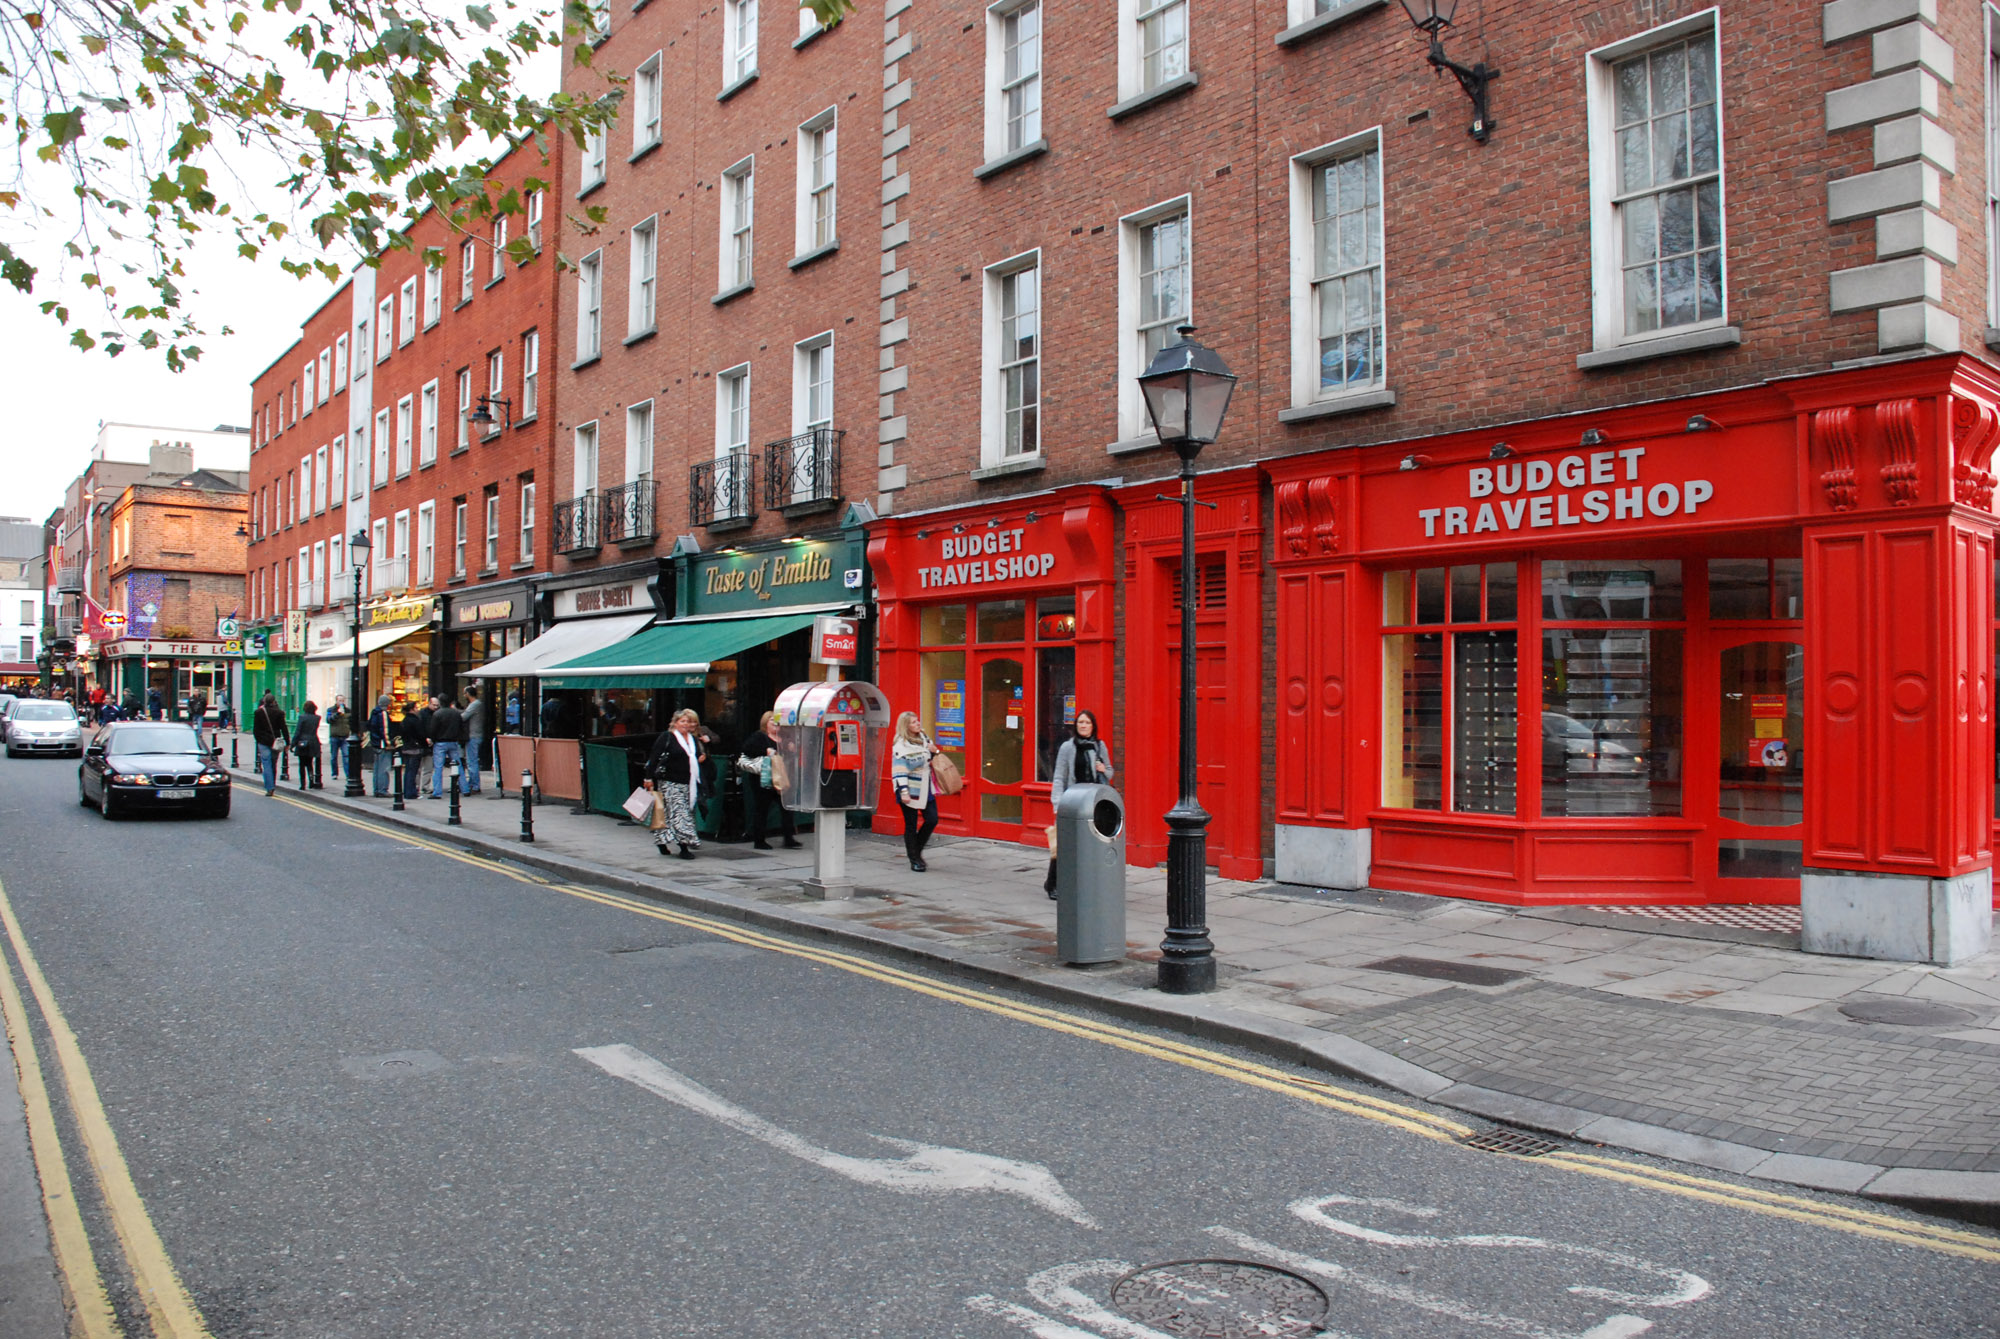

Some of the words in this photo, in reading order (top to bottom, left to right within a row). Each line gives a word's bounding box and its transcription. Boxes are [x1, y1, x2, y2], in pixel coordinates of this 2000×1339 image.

[1469, 447, 1646, 498] BUDGET
[1418, 479, 1714, 537] TRAVELSHOP
[942, 528, 1024, 560] BUDGET
[706, 565, 745, 595] Taste
[749, 558, 768, 594] of
[771, 551, 831, 586] Emilia
[918, 553, 1055, 588] TRAVELSHOP
[479, 600, 512, 620] WORKSHOP
[576, 589, 601, 612] COFFEE
[602, 584, 633, 608] SOCIETY
[169, 644, 199, 654] THE
[826, 638, 854, 649] Smart
